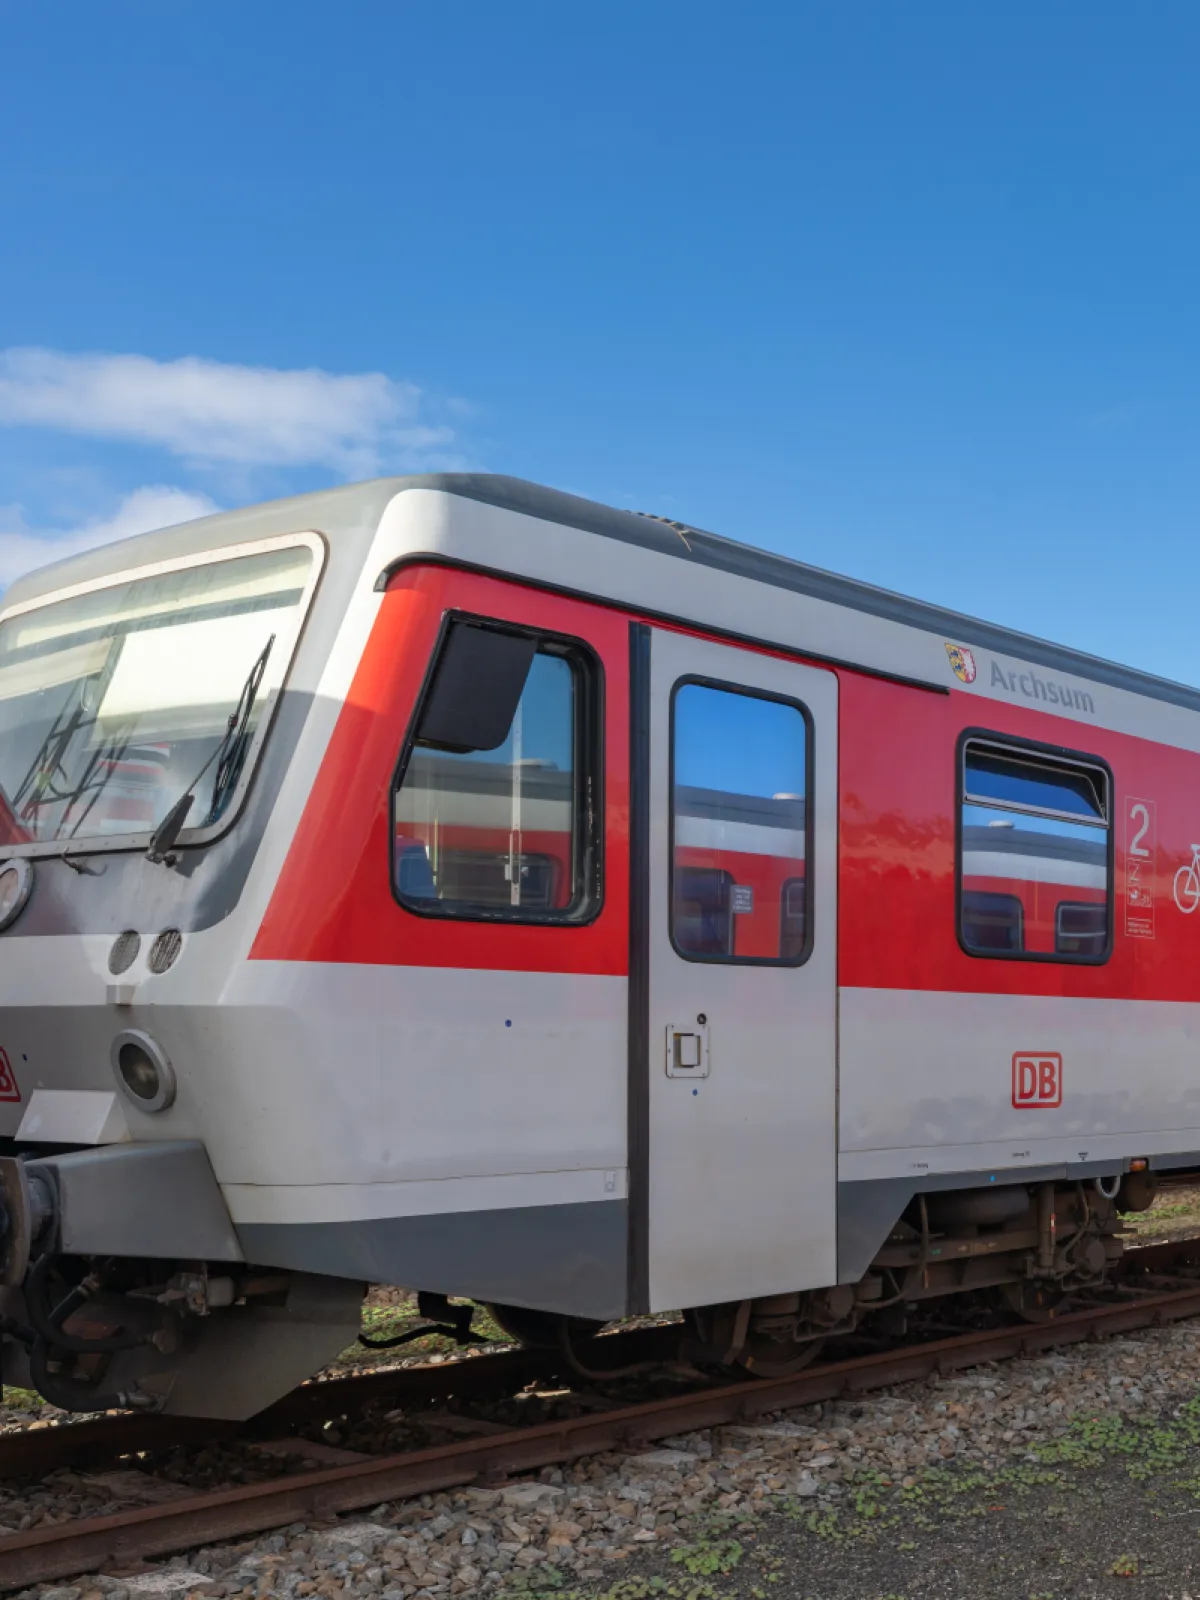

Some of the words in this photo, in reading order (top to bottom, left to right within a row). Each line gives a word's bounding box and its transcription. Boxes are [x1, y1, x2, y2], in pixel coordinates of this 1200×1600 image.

[990, 660, 1095, 714] Archsum
[1129, 803, 1150, 857] 2
[1017, 1060, 1057, 1100] DB
